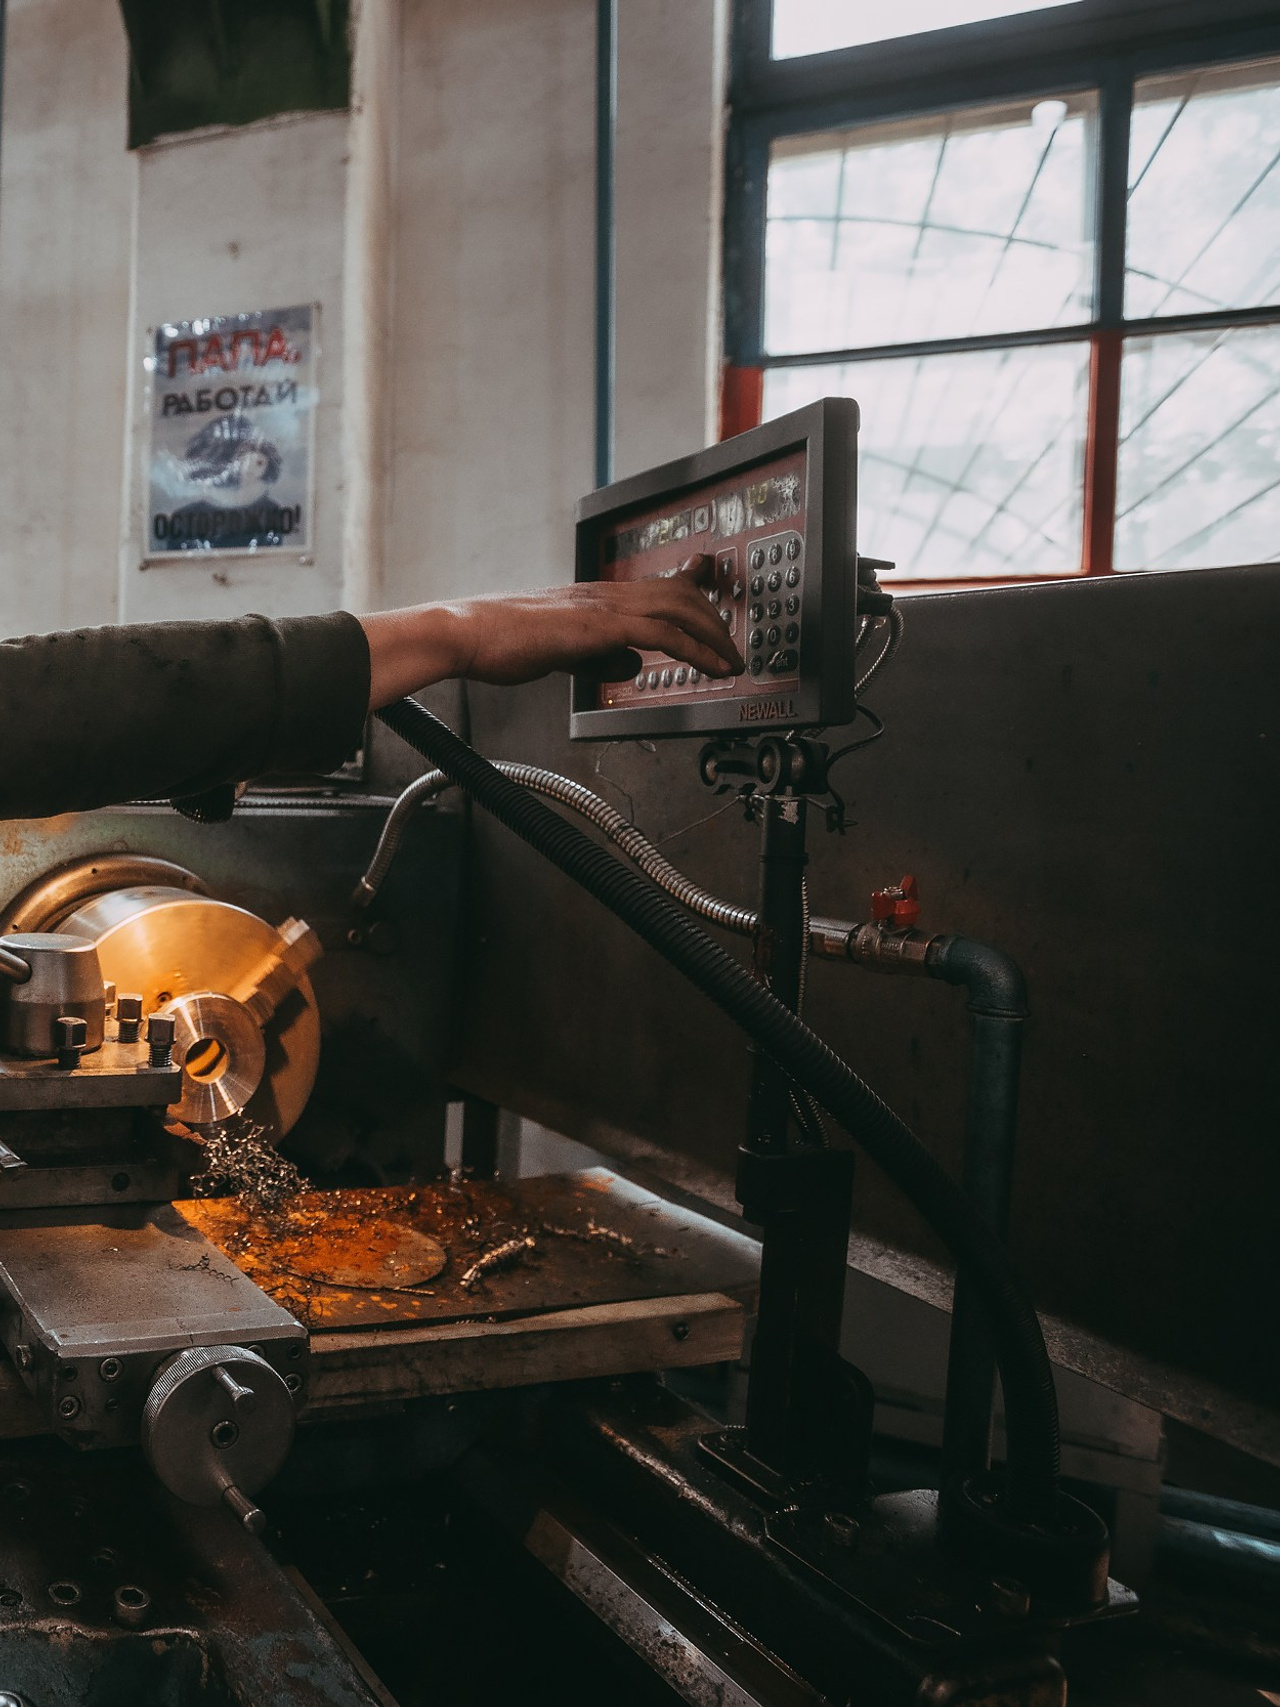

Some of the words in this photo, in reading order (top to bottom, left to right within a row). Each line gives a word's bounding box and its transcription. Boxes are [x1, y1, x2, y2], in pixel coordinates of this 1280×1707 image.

[162, 379, 298, 416] РАБОТАЙ
[770, 603, 777, 615] 2
[788, 598, 795, 611] 3
[770, 629, 777, 641] 0
[740, 701, 798, 720] NEWALL
